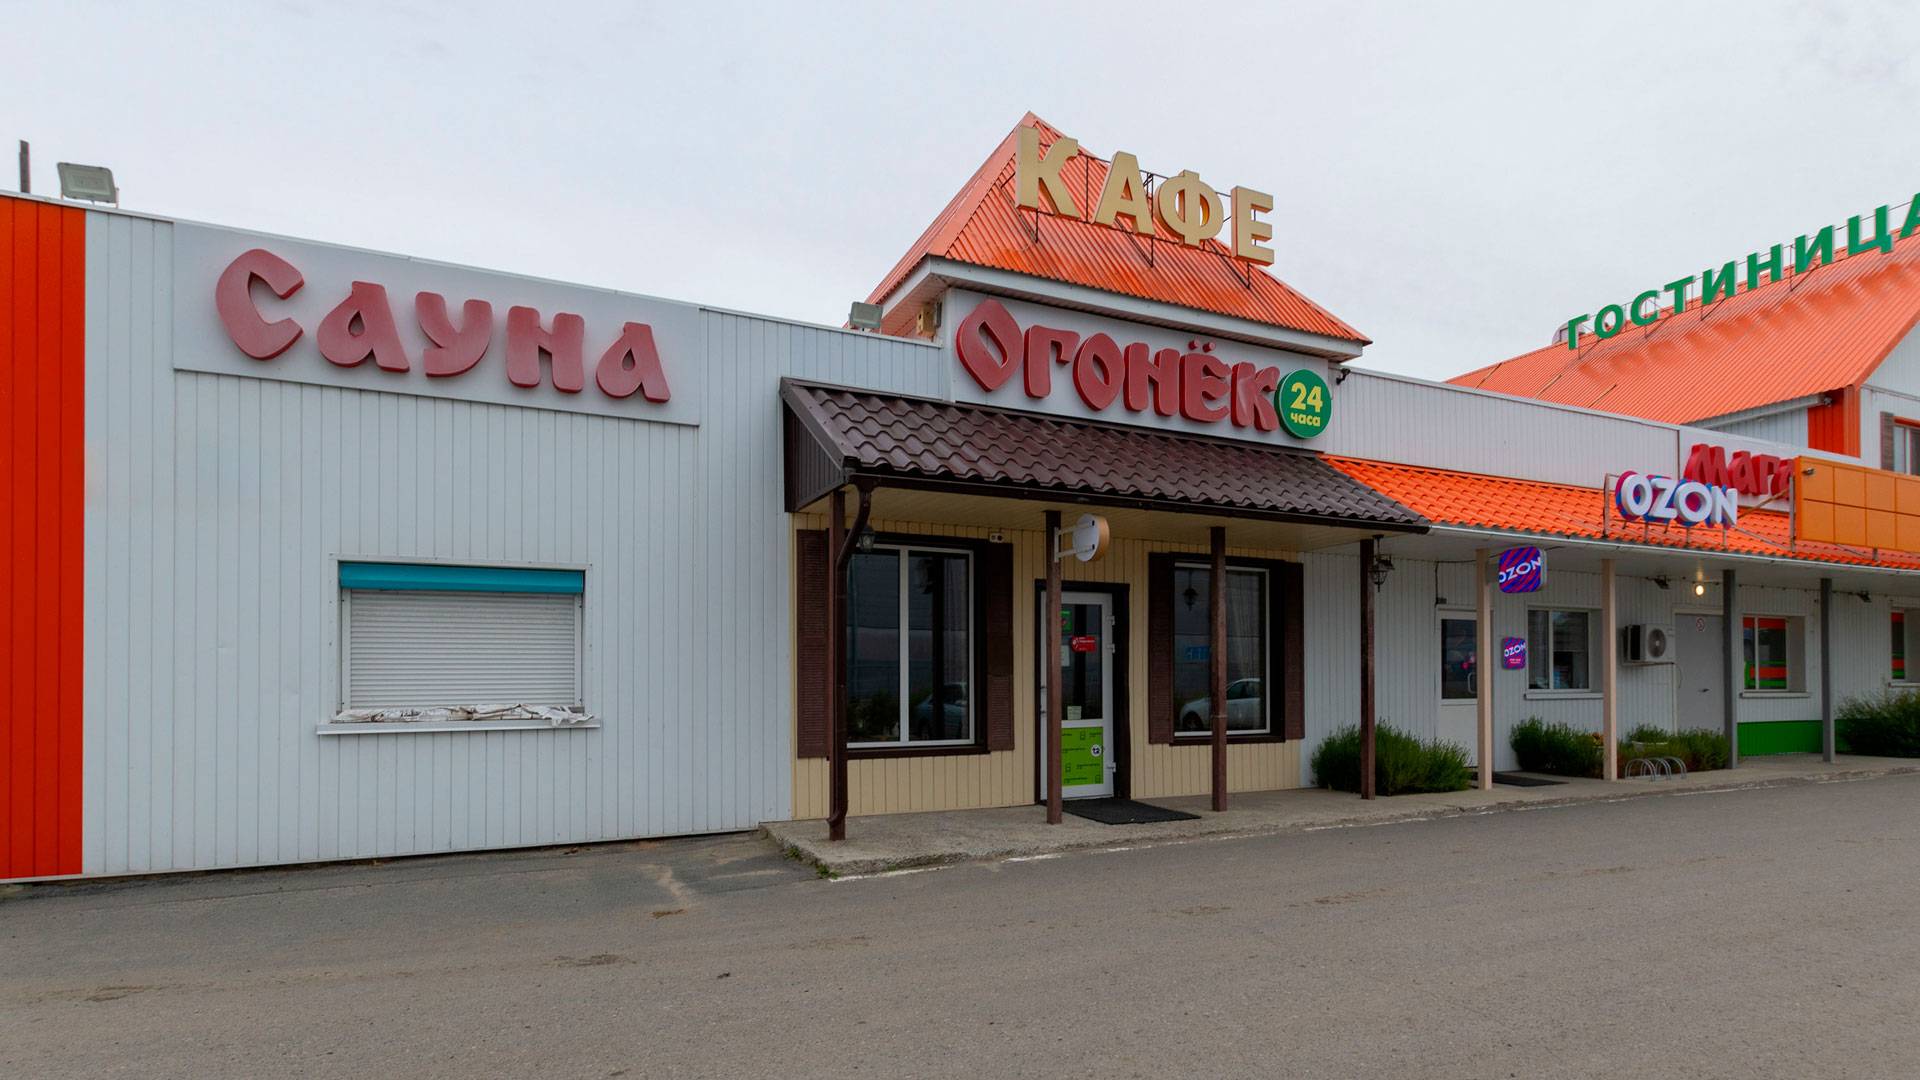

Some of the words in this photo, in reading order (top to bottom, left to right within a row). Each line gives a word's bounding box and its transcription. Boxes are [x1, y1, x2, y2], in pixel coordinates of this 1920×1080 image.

[1016, 125, 1275, 267] КАФЕ
[1291, 382, 1324, 412] 24
[1290, 412, 1321, 427] часа
[1616, 470, 1738, 528] OZON
